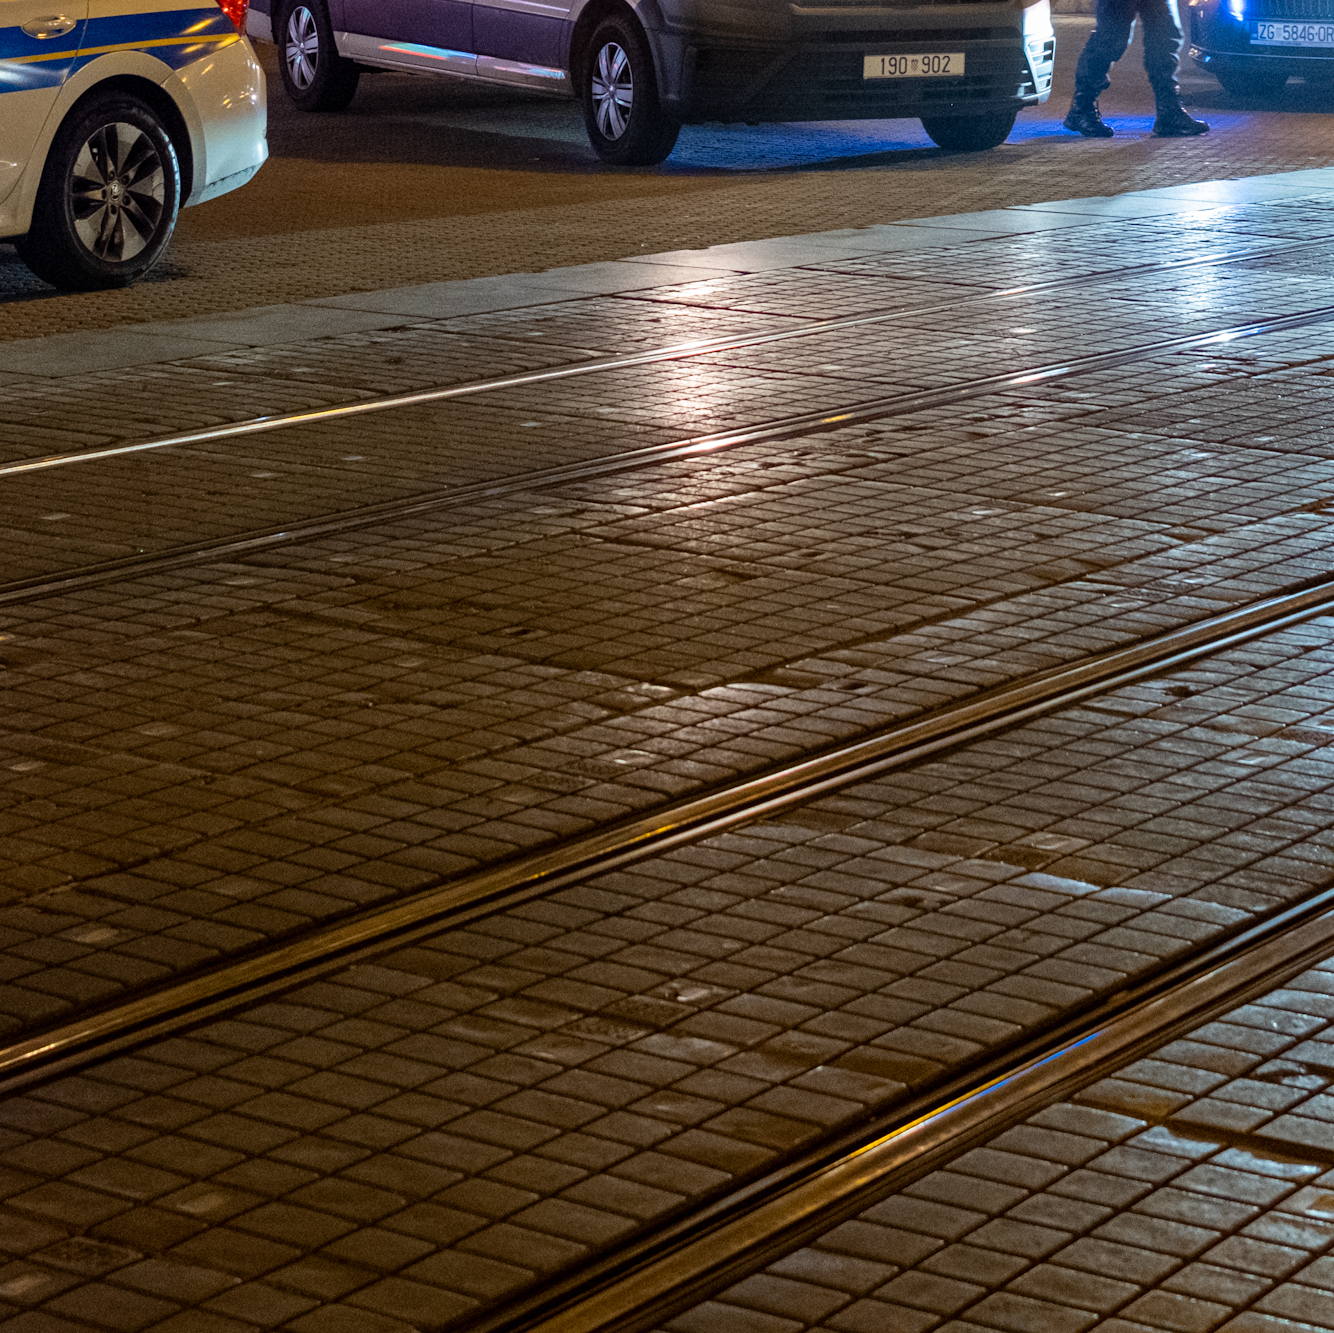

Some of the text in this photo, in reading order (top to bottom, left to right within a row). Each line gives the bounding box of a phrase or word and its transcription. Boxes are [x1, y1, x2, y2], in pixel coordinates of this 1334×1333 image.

[1259, 24, 1275, 40] ZG
[881, 55, 951, 75] 190 902
